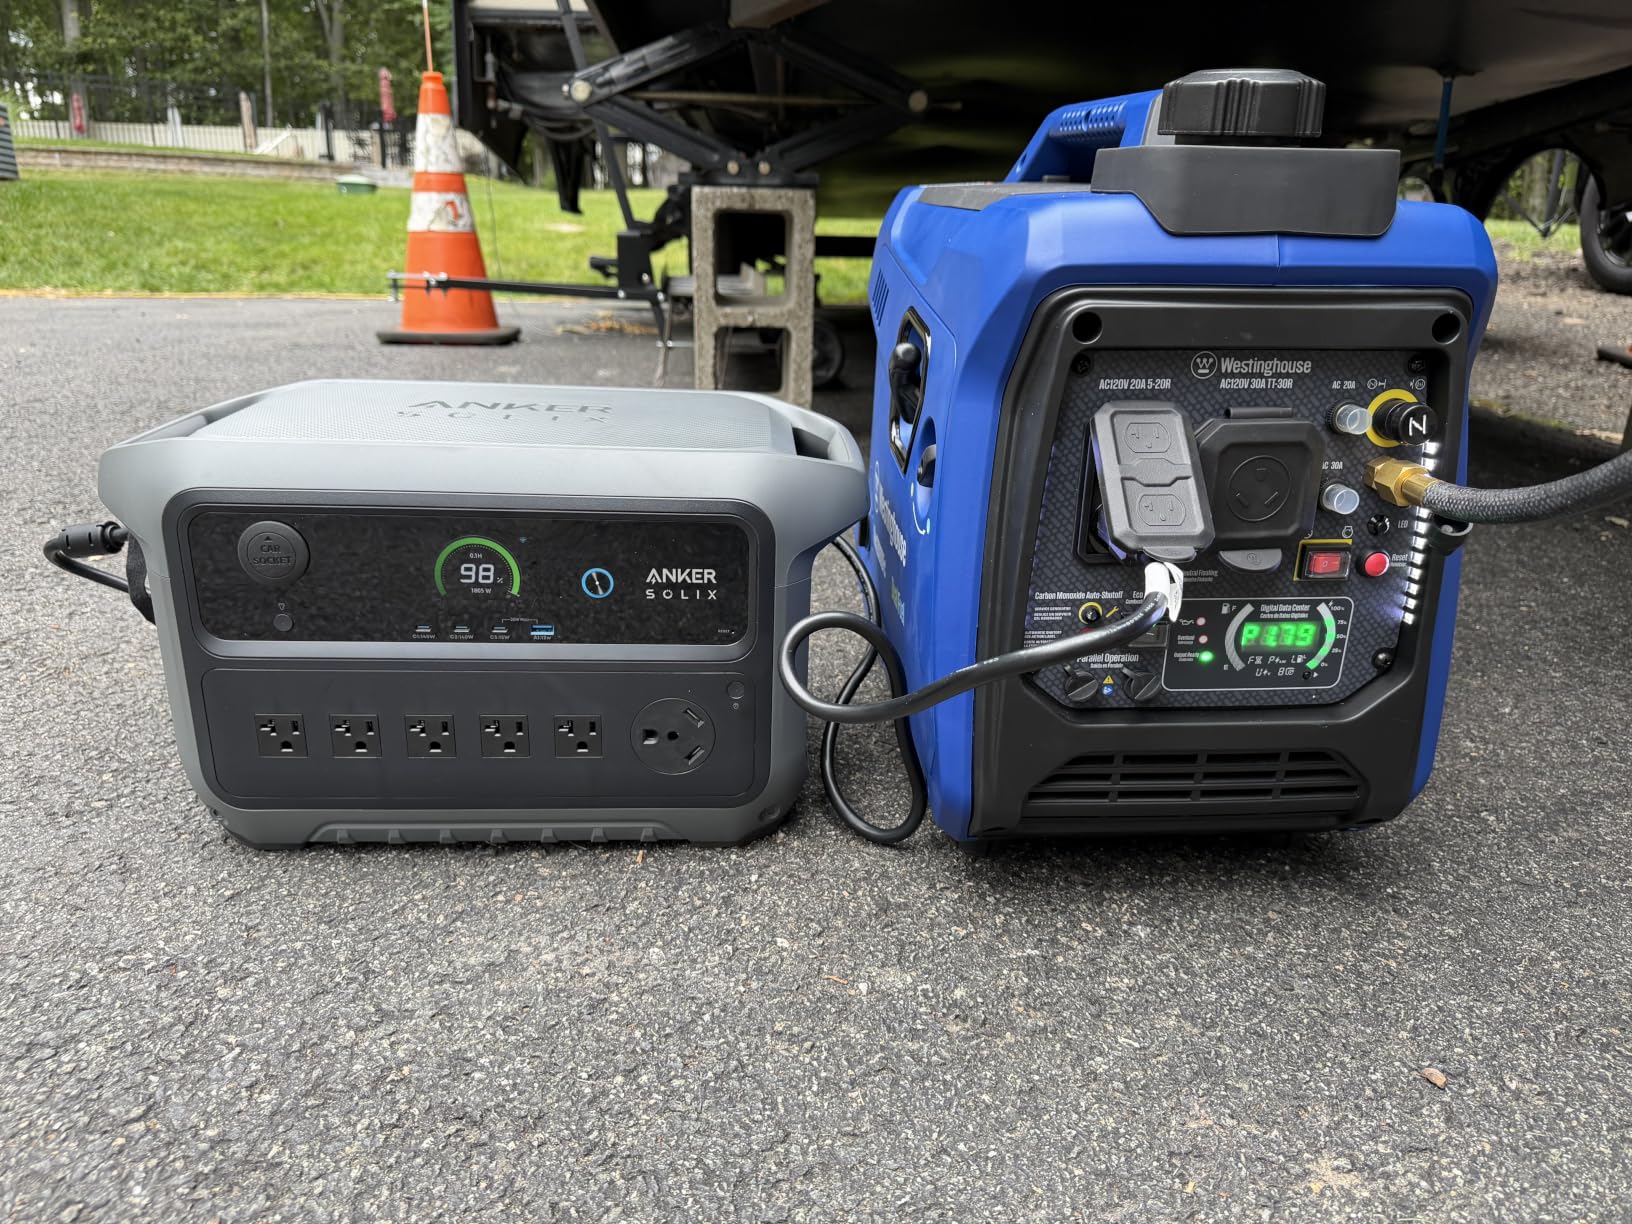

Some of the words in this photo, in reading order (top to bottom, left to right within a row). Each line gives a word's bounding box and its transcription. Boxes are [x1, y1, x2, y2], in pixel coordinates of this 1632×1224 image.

[1220, 357, 1312, 377] Westinghouse
[1098, 378, 1129, 390] AC120V
[1130, 378, 1146, 390] 20A
[1147, 378, 1171, 390] 5-20R
[1219, 378, 1250, 389] AC120V
[1250, 378, 1266, 389] 30A
[1267, 378, 1293, 389] TT-30R
[1331, 380, 1341, 390] AC
[1343, 380, 1356, 390] 20A
[408, 400, 613, 414] ANKER
[1330, 461, 1343, 470] 30A
[1397, 519, 1409, 529] LED
[260, 544, 281, 554] CAR
[252, 556, 291, 566] SOCKET
[1391, 553, 1408, 561] Reset
[645, 567, 718, 585] ANKER
[645, 588, 718, 600] SOLIX
[1034, 591, 1056, 600] Carbon
[1057, 591, 1086, 600] Monoxide
[1086, 590, 1124, 599] Auto-Shutoff
[1260, 603, 1279, 613] Digital
[1279, 603, 1292, 612] Data
[1292, 603, 1311, 612] Center
[1104, 652, 1139, 664] Operation
